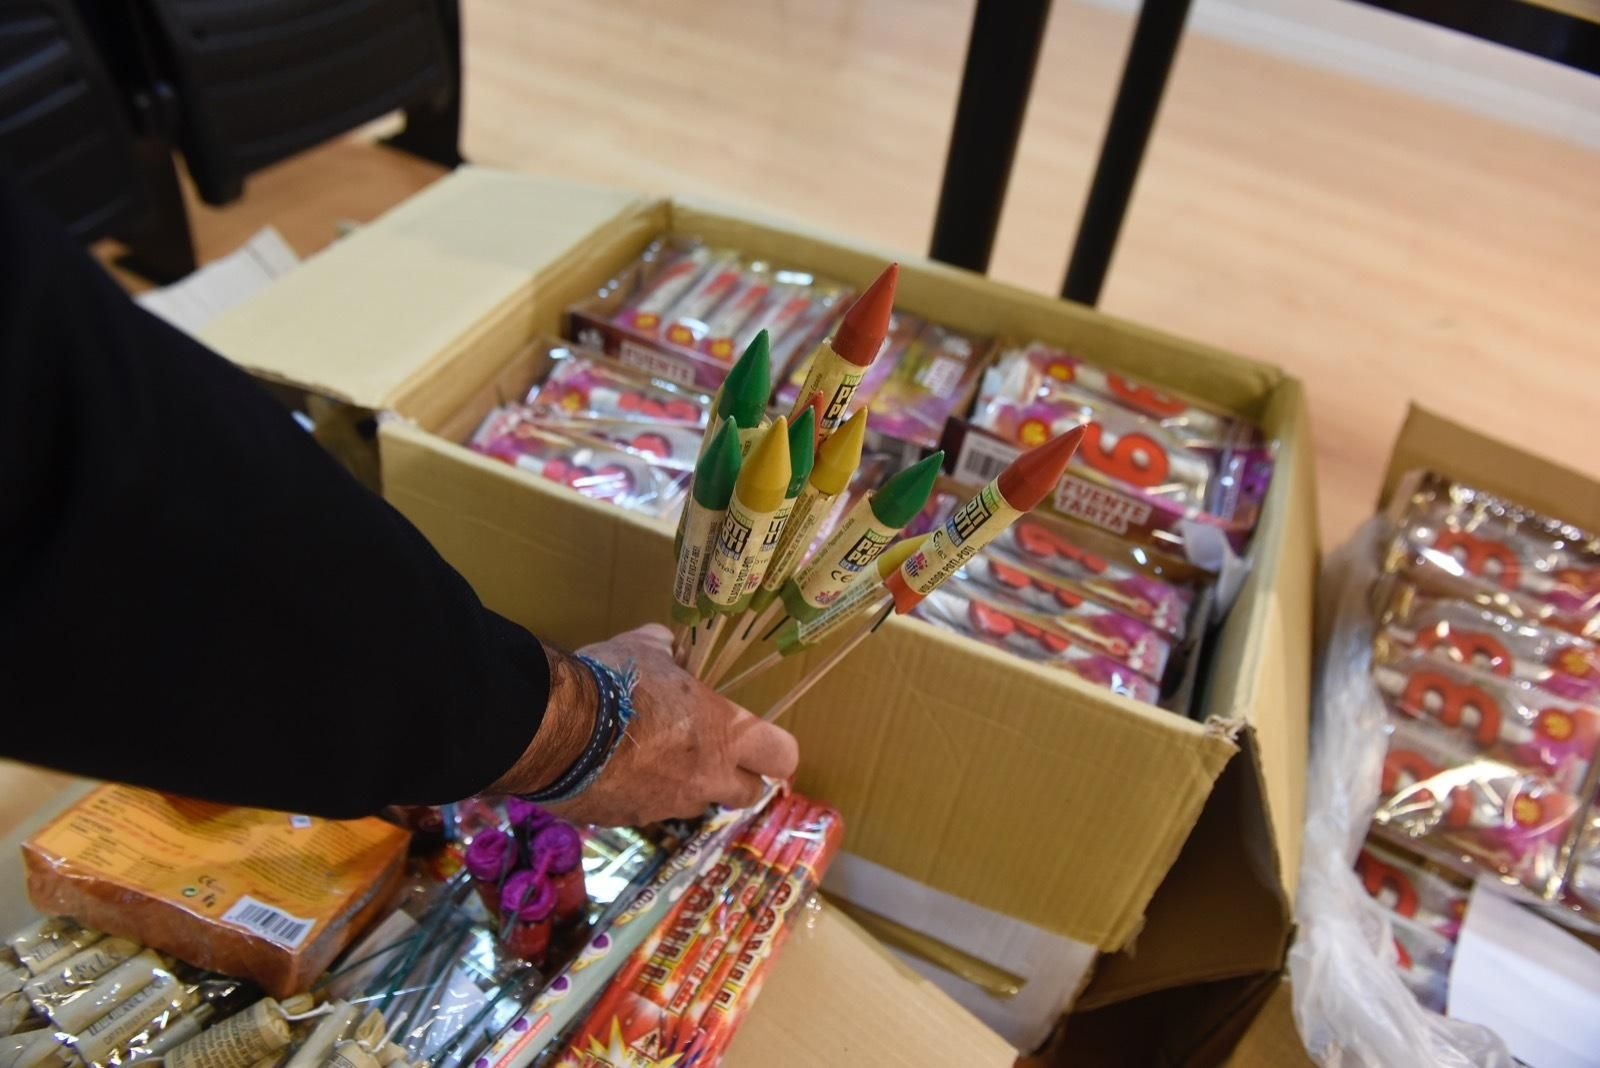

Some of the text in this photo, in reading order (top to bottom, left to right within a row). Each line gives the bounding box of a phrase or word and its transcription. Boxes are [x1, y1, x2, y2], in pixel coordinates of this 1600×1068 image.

[1056, 493, 1127, 530] TARTA
[1061, 480, 1143, 520] FUENTE
[942, 543, 975, 574] POTI-POTI
